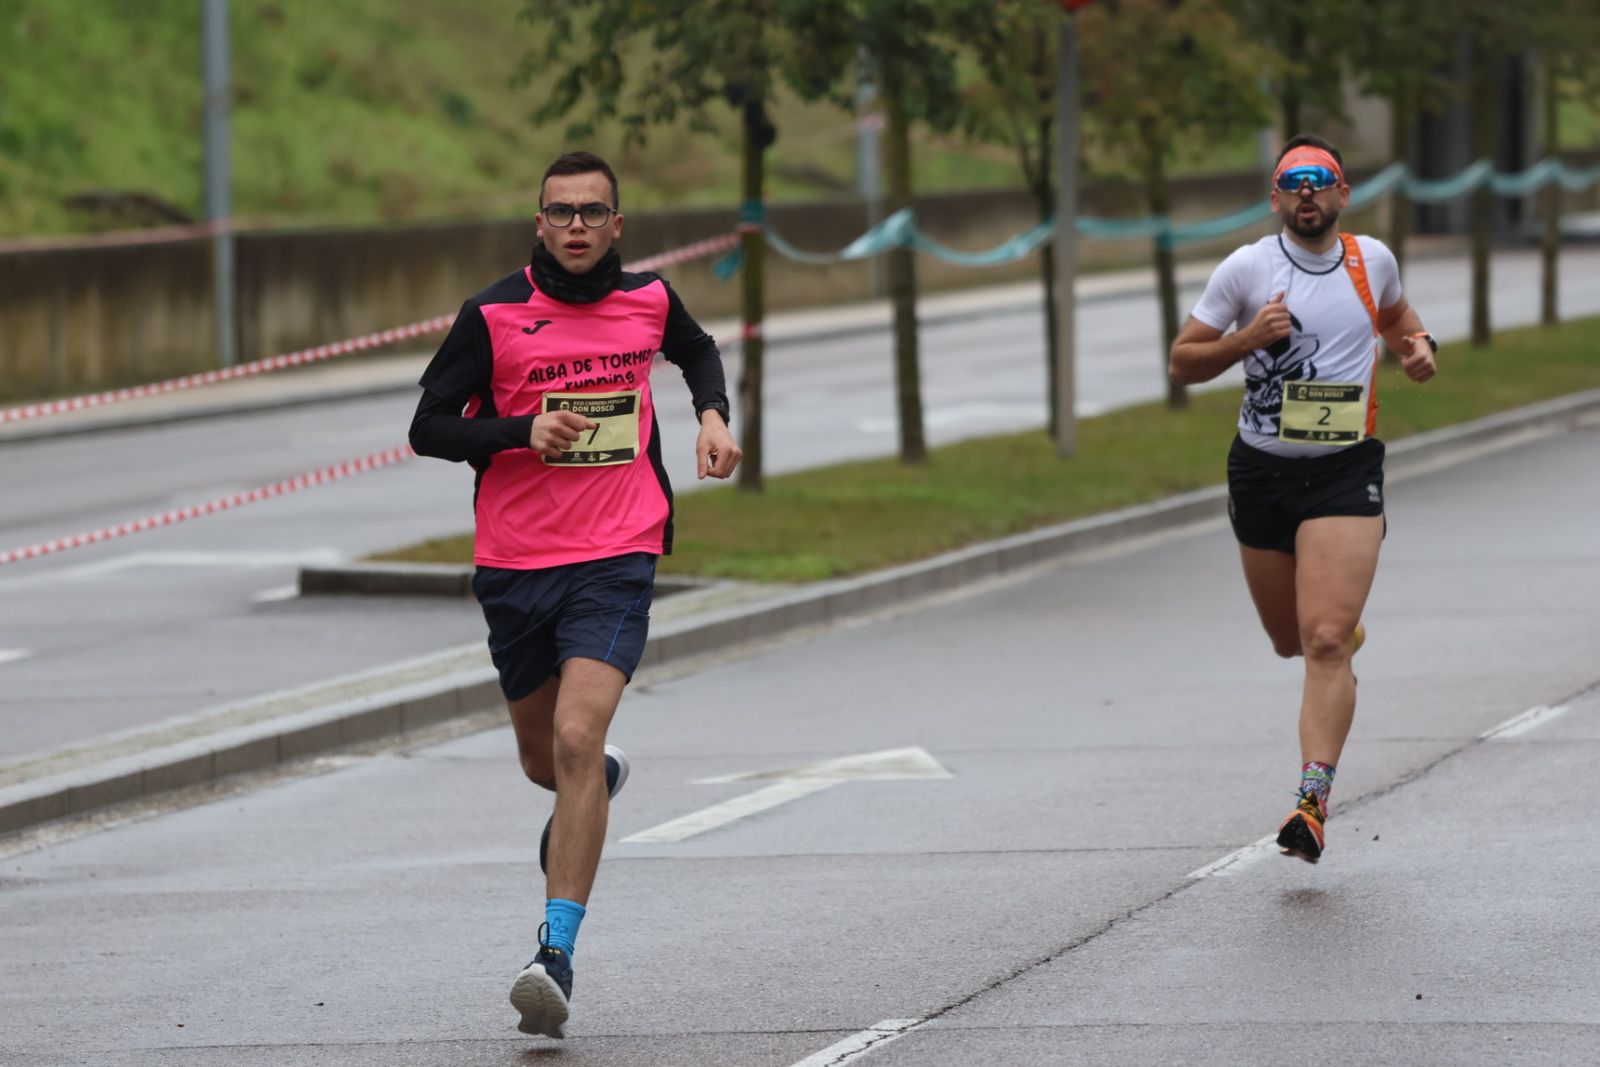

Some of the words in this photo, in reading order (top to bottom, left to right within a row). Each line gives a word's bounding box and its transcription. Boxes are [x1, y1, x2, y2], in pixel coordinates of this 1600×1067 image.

[528, 363, 567, 383] ALBA
[573, 358, 592, 375] DE
[565, 370, 635, 390] running
[572, 405, 589, 413] DON
[590, 404, 615, 412] BOSCO
[1317, 406, 1331, 426] 2
[587, 423, 600, 445] 7
